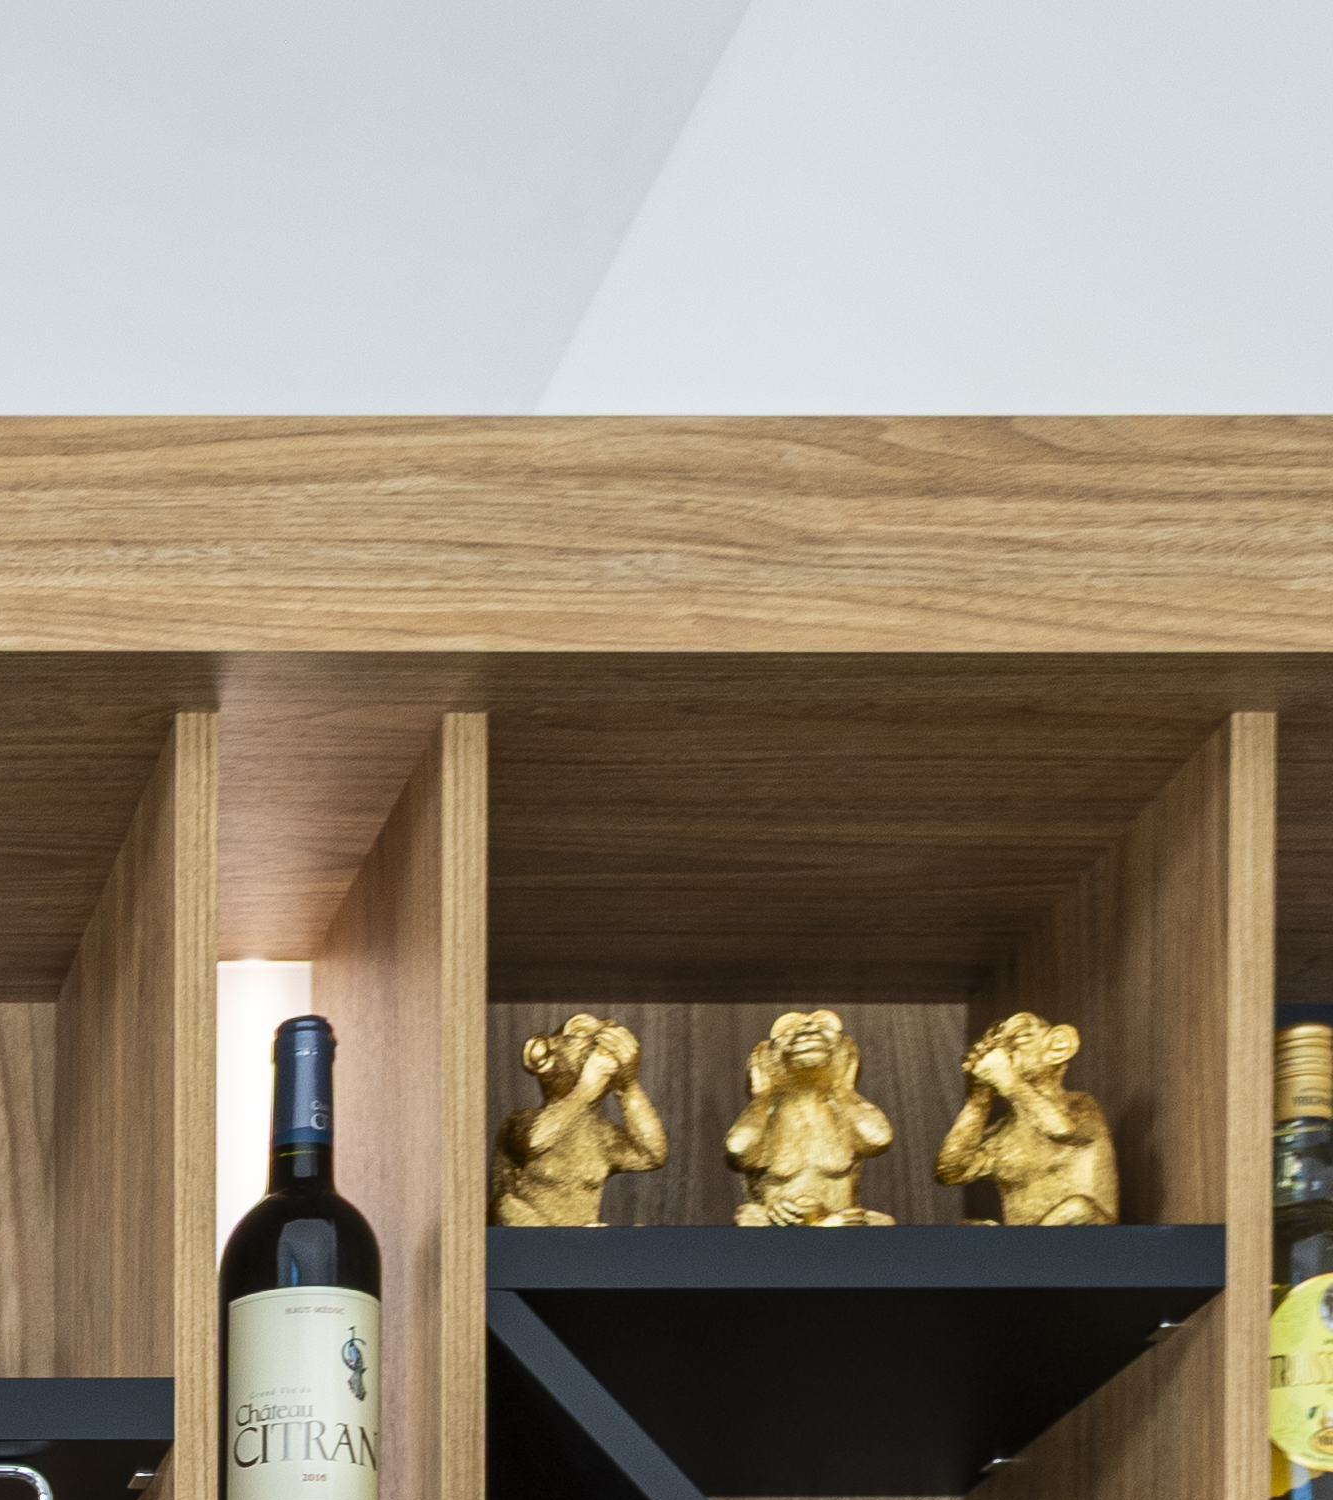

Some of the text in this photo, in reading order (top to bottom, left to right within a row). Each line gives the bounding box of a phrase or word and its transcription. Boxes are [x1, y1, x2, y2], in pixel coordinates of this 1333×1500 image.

[236, 1402, 314, 1428] Château
[234, 1420, 379, 1472] CITRAN
[302, 1473, 329, 1483] 2016
